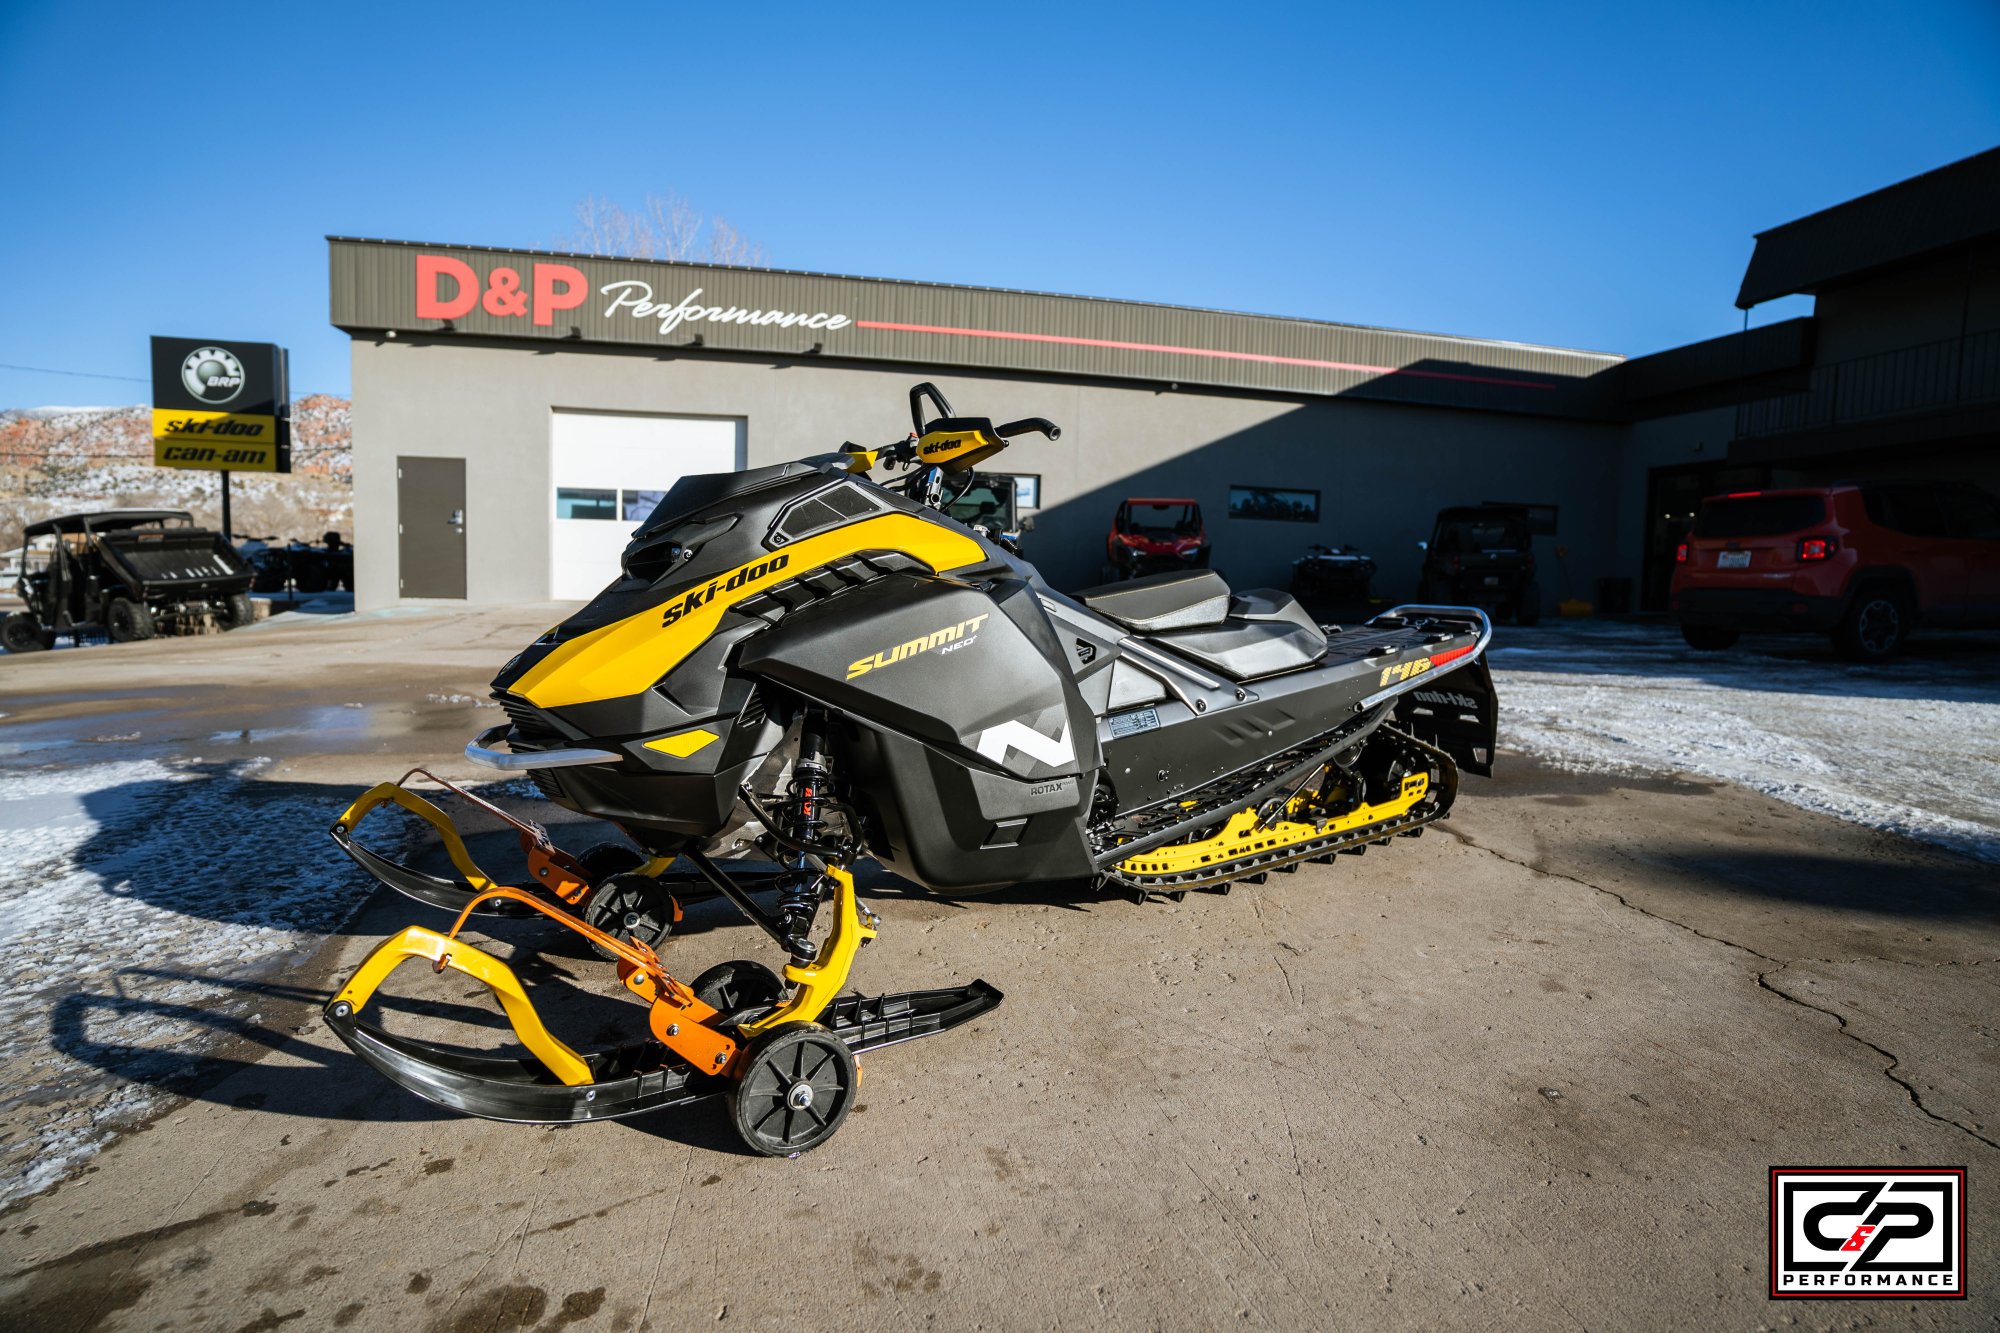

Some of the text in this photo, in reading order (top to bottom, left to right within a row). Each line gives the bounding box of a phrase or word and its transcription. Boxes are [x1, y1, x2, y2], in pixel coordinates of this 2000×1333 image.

[416, 254, 852, 335] D&P Performance
[207, 376, 240, 387] BRP
[164, 418, 264, 436] ski-doo
[163, 446, 266, 464] can-am
[923, 439, 962, 454] ski-doo
[661, 554, 790, 629] ski-doo
[846, 613, 990, 680] SUMMIT
[1379, 657, 1432, 687] 146
[1030, 783, 1063, 796] ROTAX
